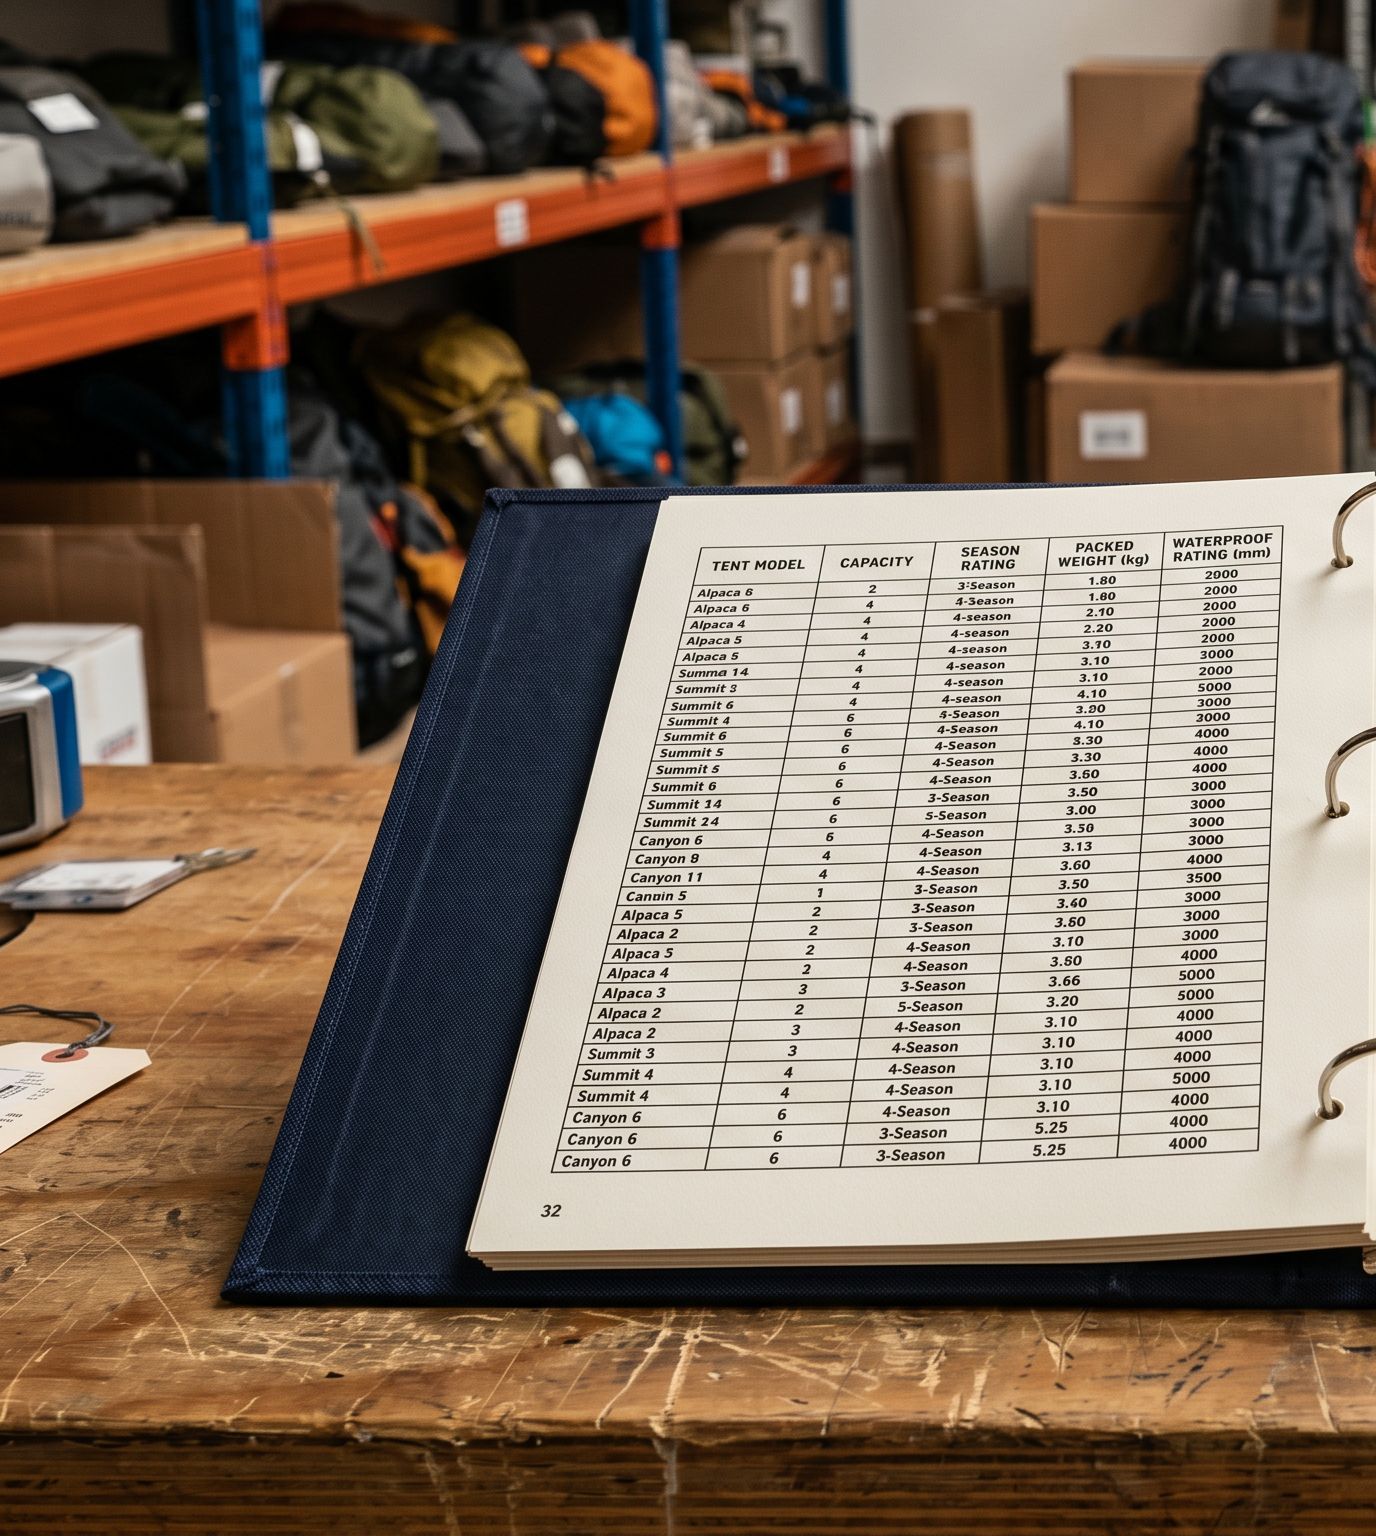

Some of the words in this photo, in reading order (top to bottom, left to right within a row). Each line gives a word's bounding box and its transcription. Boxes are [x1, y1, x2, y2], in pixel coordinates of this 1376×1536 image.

[960, 544, 1021, 558] SEASON
[1075, 540, 1134, 554] PACKED
[1172, 532, 1274, 549] WATERPROOF
[1173, 548, 1228, 563] RATING
[1233, 546, 1271, 560] (mm)
[712, 560, 751, 572] TENT
[754, 558, 806, 571] MODEL
[839, 555, 914, 569] CAPACITY
[960, 558, 1016, 572] RATING
[1058, 554, 1117, 568] WEIGHT
[1120, 553, 1150, 568] (kg)
[685, 635, 731, 648] Alpaca
[733, 635, 743, 645] 5
[860, 632, 869, 641] 4
[950, 629, 1010, 639] 4-season
[1083, 623, 1114, 634] 2.20
[1201, 616, 1236, 628] 2000
[670, 700, 723, 712] Summit
[725, 700, 734, 710] 6
[848, 697, 858, 707] 4
[941, 694, 1002, 705] 4-season
[1076, 688, 1107, 699] 4.10
[1197, 681, 1232, 693] 5000
[655, 763, 709, 776] Summit
[710, 764, 721, 774] 5
[838, 761, 847, 771] 6
[931, 757, 995, 768] 4-Season
[1070, 751, 1102, 763] 3.30
[1193, 744, 1229, 757] 4000
[646, 798, 701, 811] Summit
[704, 799, 722, 809] 14
[832, 796, 841, 807] 6
[927, 792, 990, 804] 3-Season
[1067, 786, 1099, 798] 3.50
[1191, 780, 1227, 792] 3000
[642, 816, 697, 828] Summit
[700, 816, 720, 827] 24
[828, 813, 838, 824] 6
[924, 810, 987, 821] 5-Season
[1065, 804, 1097, 816] 3.00
[1189, 798, 1226, 810] 3000
[630, 872, 682, 886] Canyon
[687, 871, 703, 883] 11
[818, 868, 828, 880] 4
[916, 864, 980, 877] 4-Season
[1059, 859, 1091, 872] 3.60
[1186, 852, 1223, 865] 4000
[601, 987, 653, 1002] Alpaca
[655, 986, 667, 999] 3
[798, 983, 808, 995] 3
[900, 979, 966, 993] 3-Season
[1047, 974, 1081, 988] 3.66
[1178, 967, 1216, 981] 5000
[596, 1007, 648, 1022] Alpaca
[651, 1007, 662, 1019] 2
[793, 1003, 805, 1016] 2
[897, 1000, 964, 1013] 5-Season
[1045, 994, 1079, 1008] 3.20
[1177, 988, 1215, 1001] 5000
[587, 1047, 642, 1061] Summit
[645, 1047, 656, 1060] 3
[787, 1044, 798, 1057] 3
[891, 1041, 959, 1054] 4-Season
[1041, 1035, 1076, 1050] 3.10
[1174, 1029, 1213, 1043] 4000
[567, 1132, 623, 1149] Canyon
[627, 1132, 638, 1146] 6
[772, 1130, 783, 1143] 6
[878, 1126, 948, 1140] 3-Season
[1034, 1120, 1068, 1135] 5.25
[1169, 1114, 1209, 1128] 4000
[540, 1204, 562, 1218] 32
